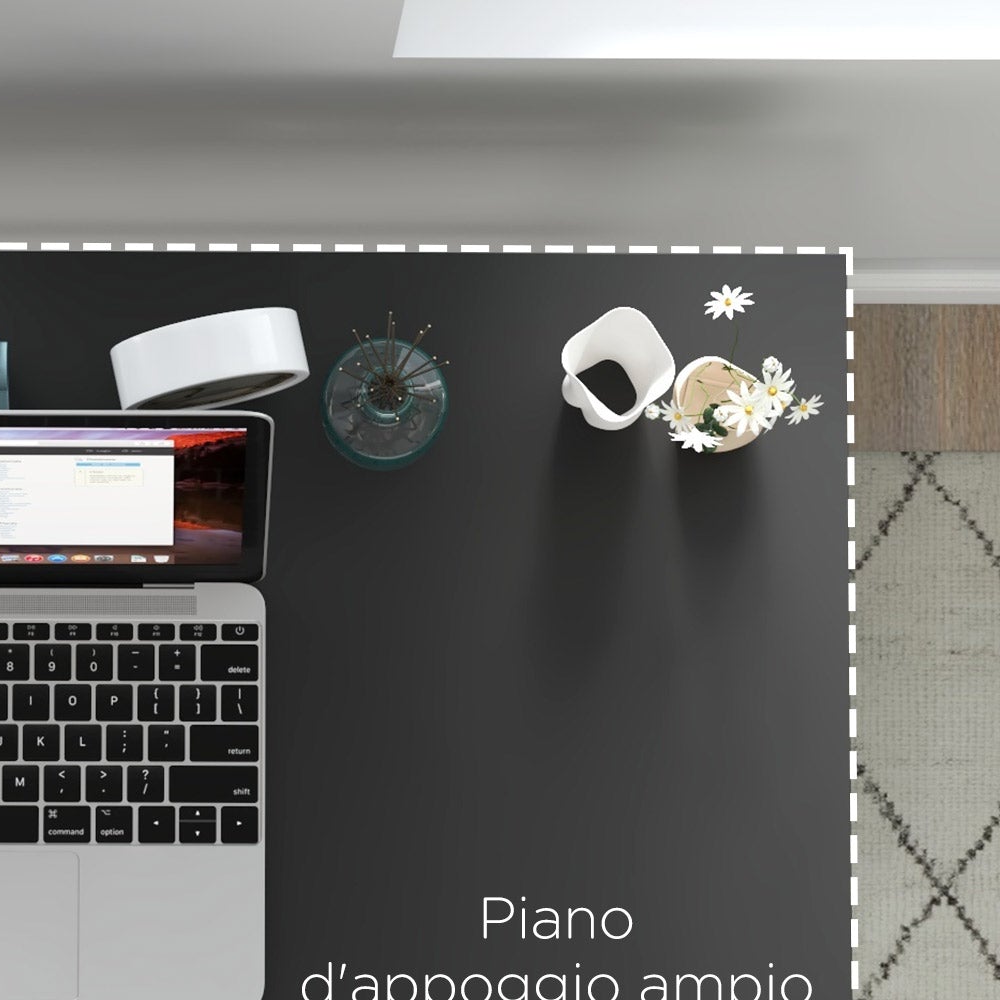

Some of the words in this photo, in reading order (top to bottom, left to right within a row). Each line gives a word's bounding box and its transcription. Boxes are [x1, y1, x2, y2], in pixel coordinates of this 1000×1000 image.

[6, 660, 15, 672] 8
[47, 661, 56, 672] 9
[89, 661, 98, 673] 0
[227, 666, 251, 674] delete
[68, 695, 77, 707] O
[110, 695, 119, 706] P
[36, 736, 45, 747] K
[79, 736, 86, 747] L
[15, 776, 25, 787] M
[232, 788, 251, 796] shift
[47, 828, 85, 836] command
[100, 828, 125, 837] option
